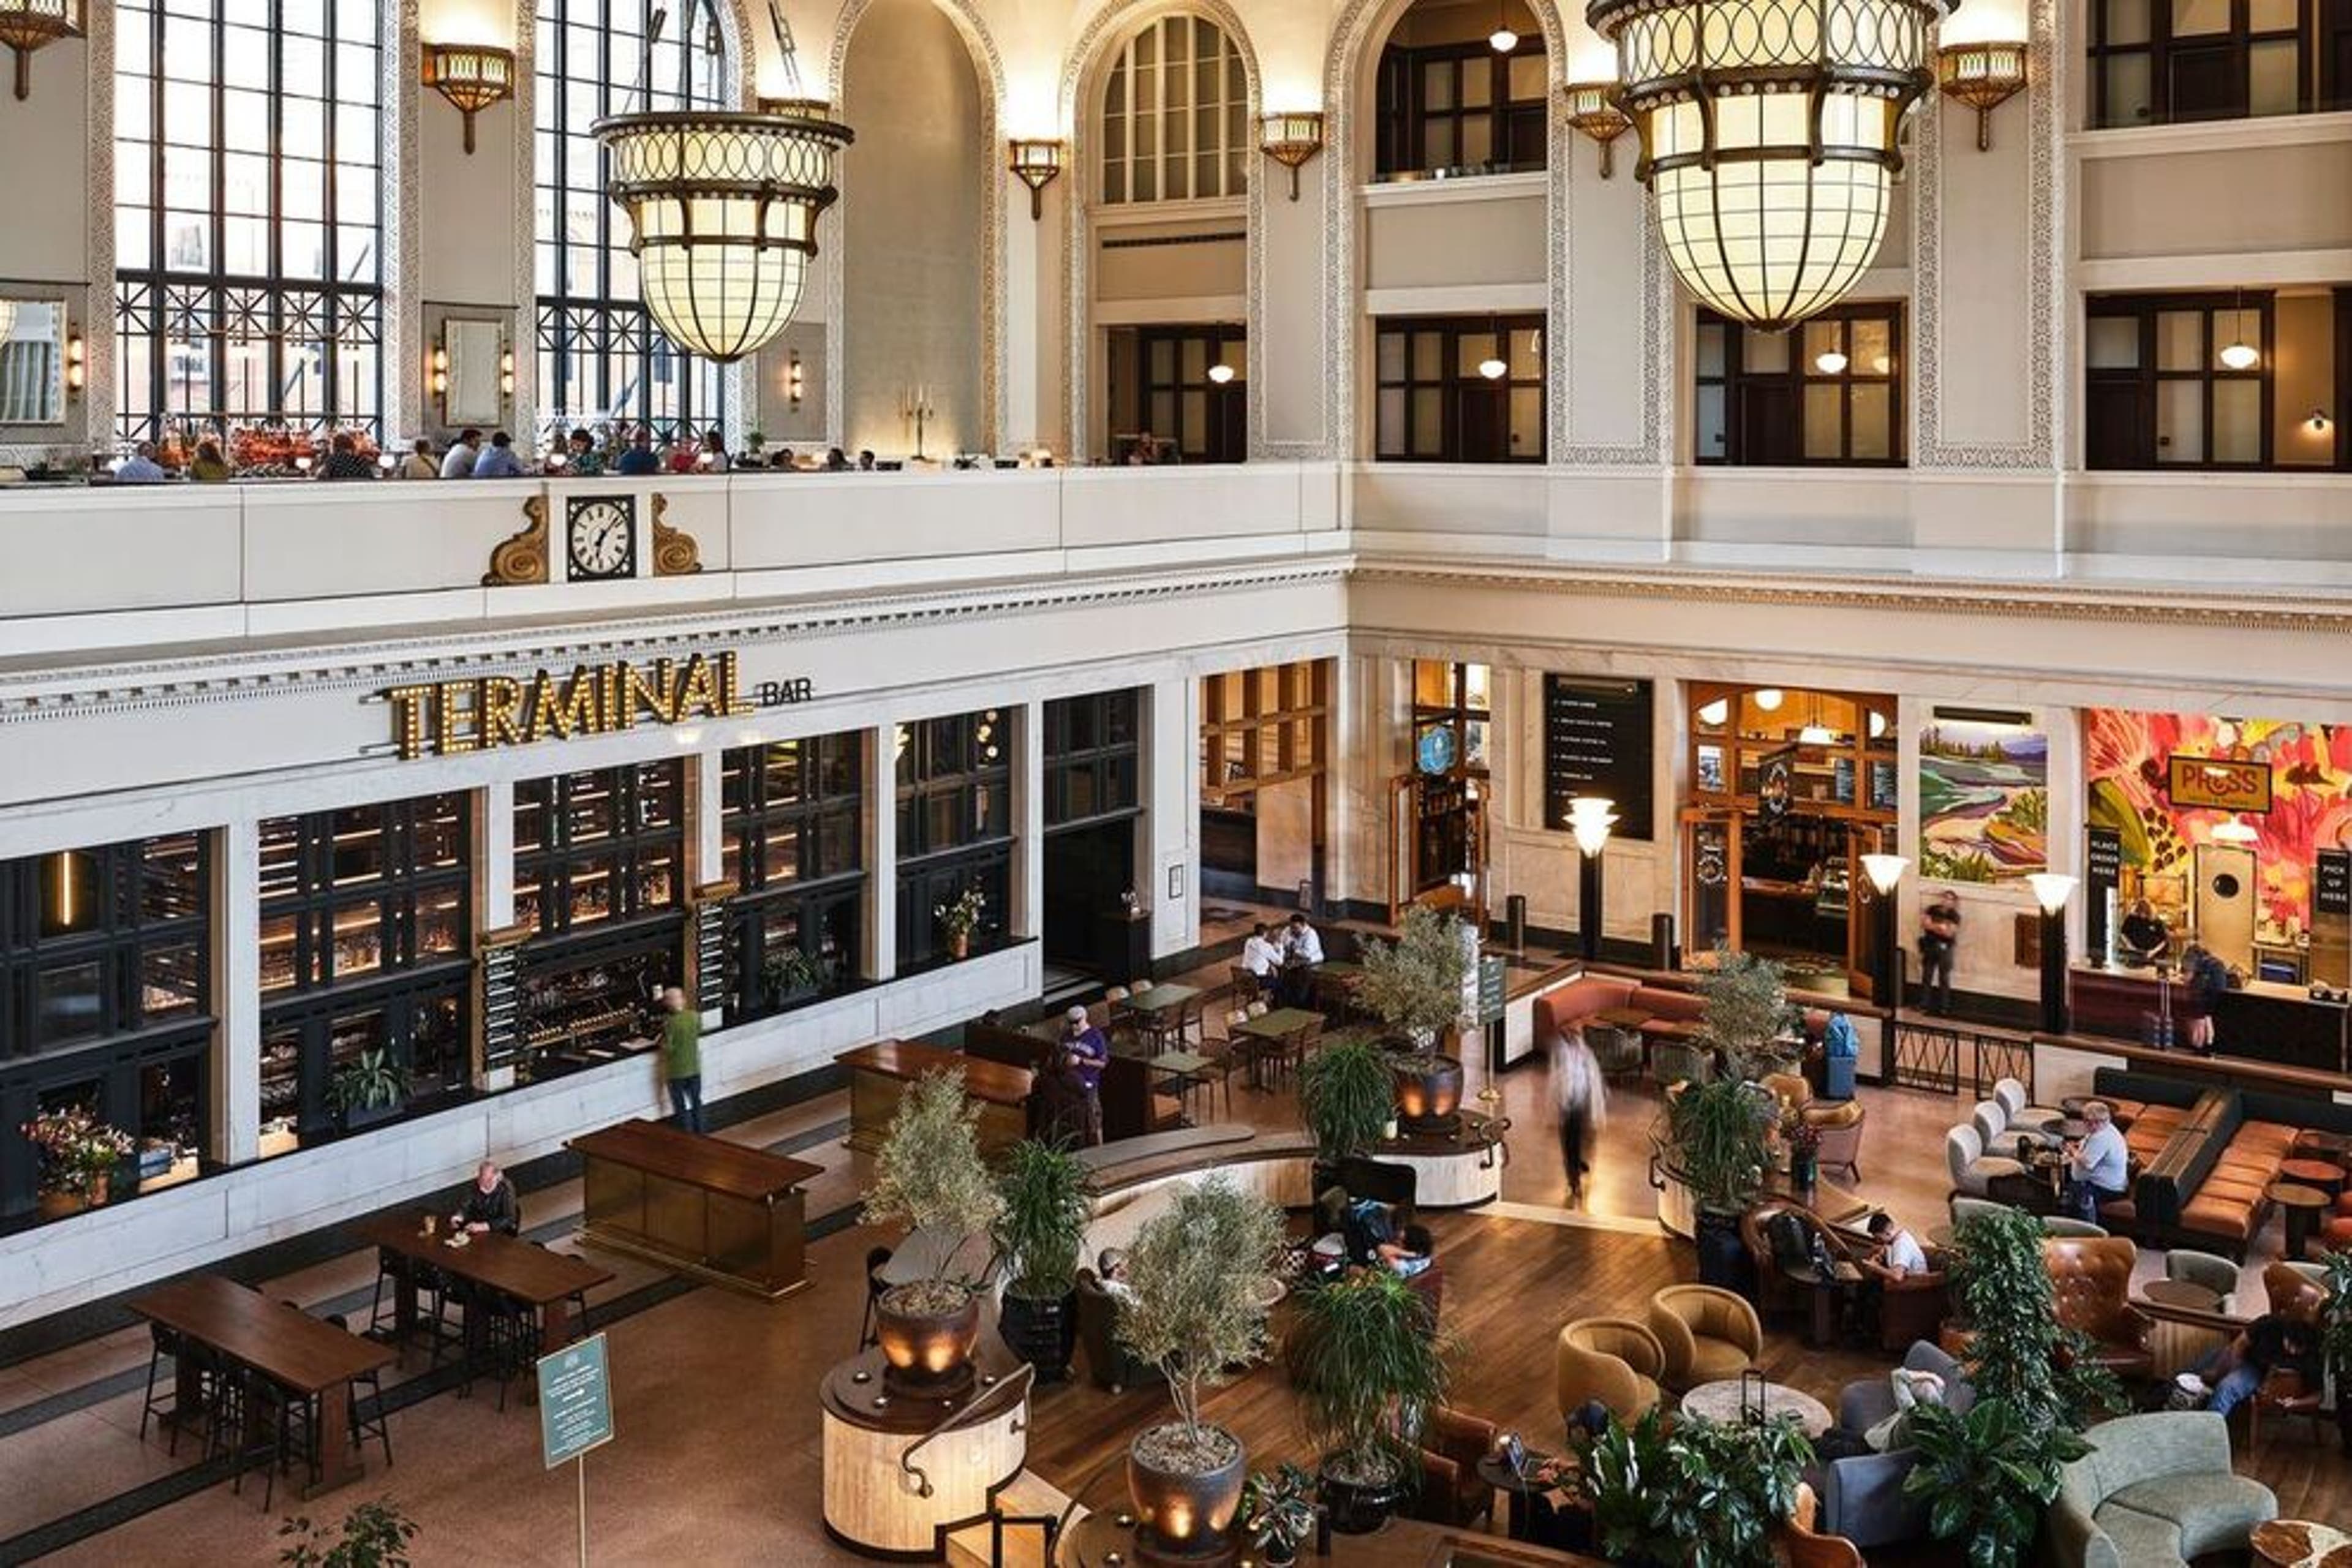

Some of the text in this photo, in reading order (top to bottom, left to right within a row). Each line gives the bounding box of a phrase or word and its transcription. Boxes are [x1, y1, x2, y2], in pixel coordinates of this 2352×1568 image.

[386, 650, 811, 760] TERMINAL BAR
[2090, 840, 2118, 851] PLACE
[2090, 852, 2119, 864] ORDER
[2092, 866, 2116, 876] HERE
[2323, 865, 2345, 875] PICK
[2328, 878, 2342, 888] UP
[2320, 892, 2348, 902] HERE
